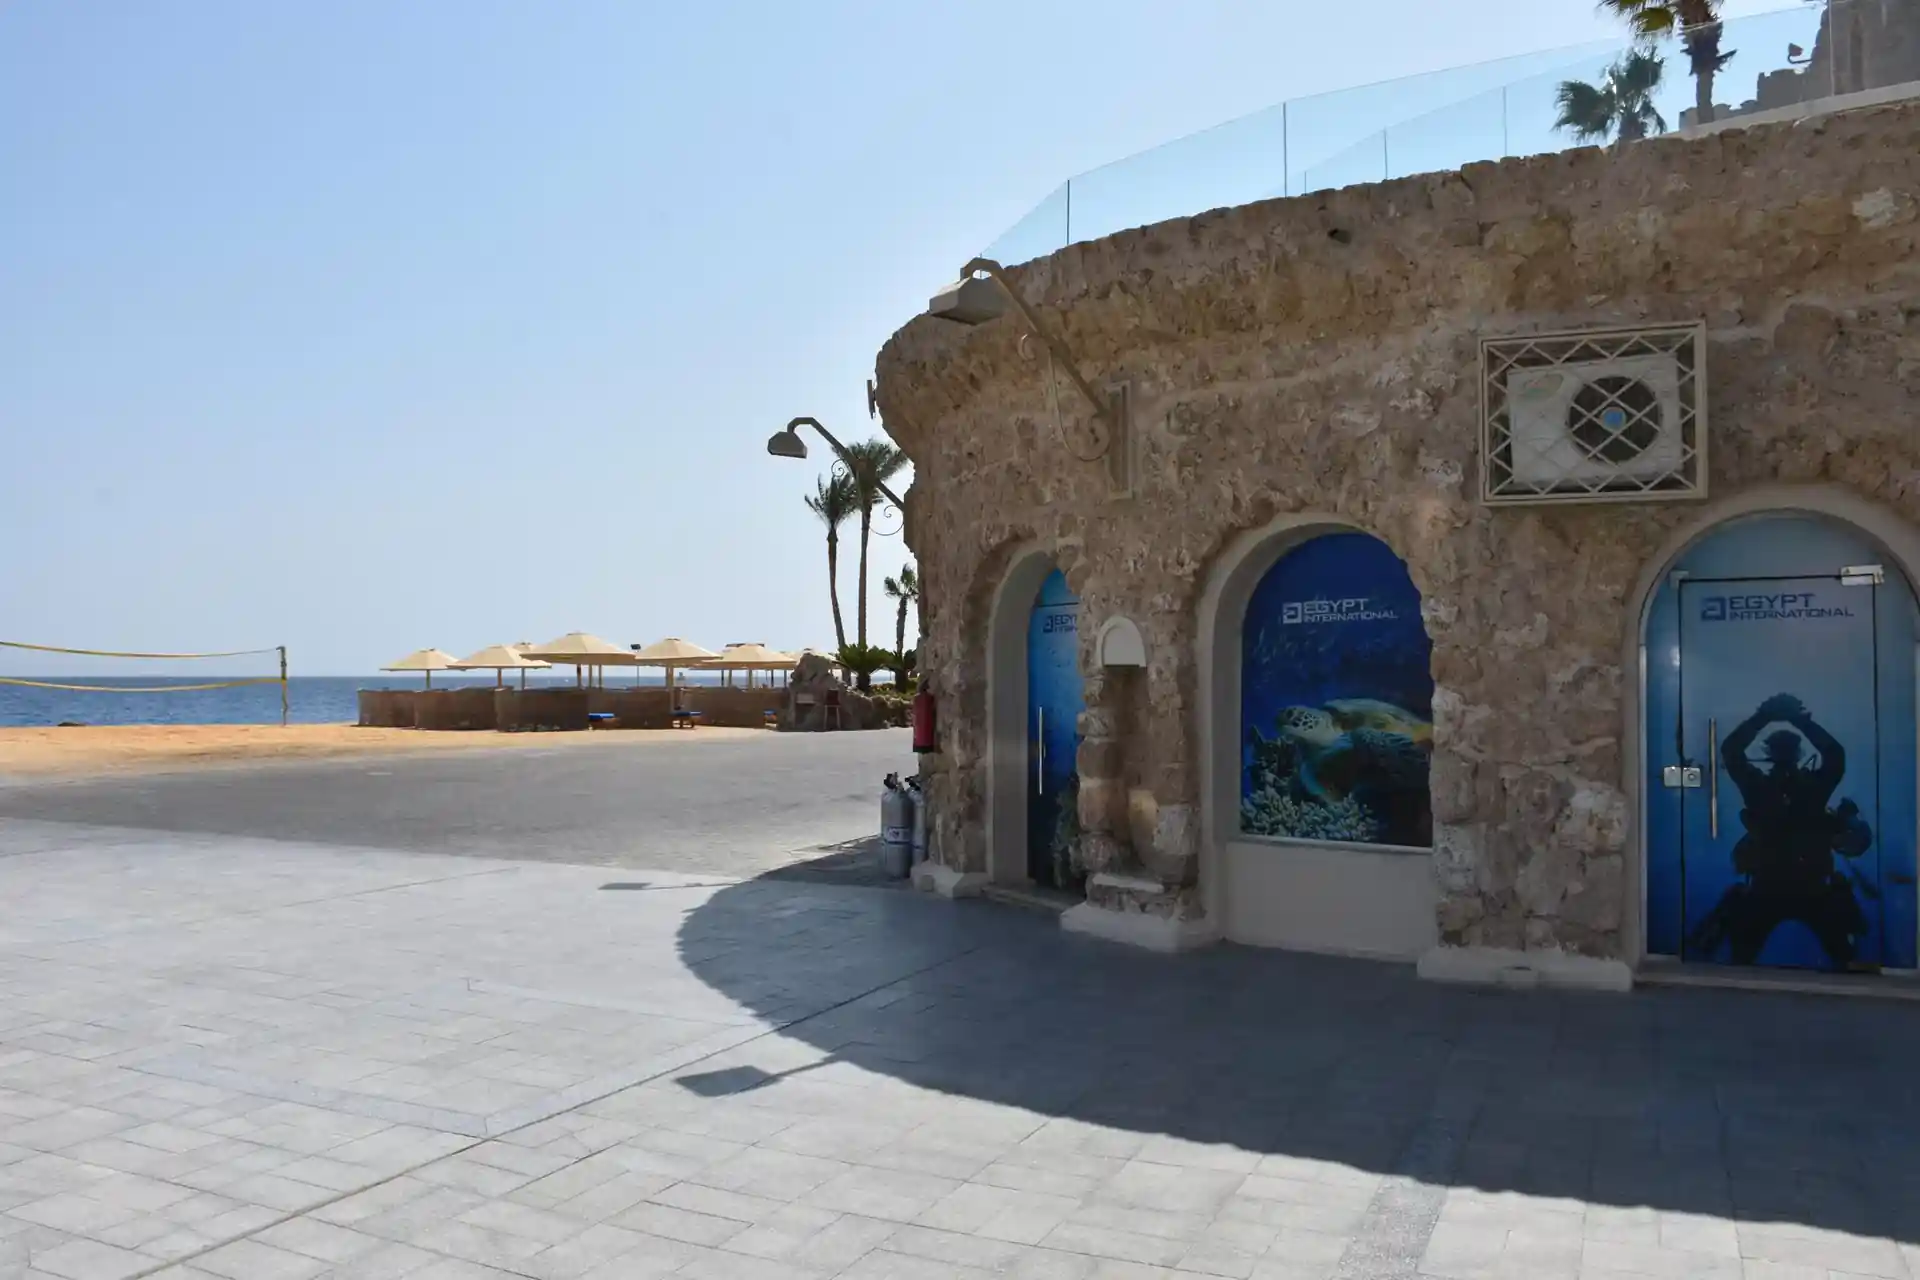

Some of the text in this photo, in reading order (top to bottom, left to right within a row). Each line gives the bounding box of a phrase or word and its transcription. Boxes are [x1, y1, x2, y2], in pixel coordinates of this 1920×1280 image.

[1303, 598, 1369, 614] EGYPT
[1729, 593, 1816, 610] EGYPT
[1303, 610, 1399, 623] INTERNATIONAL
[1729, 606, 1855, 621] INTERNATIONAL
